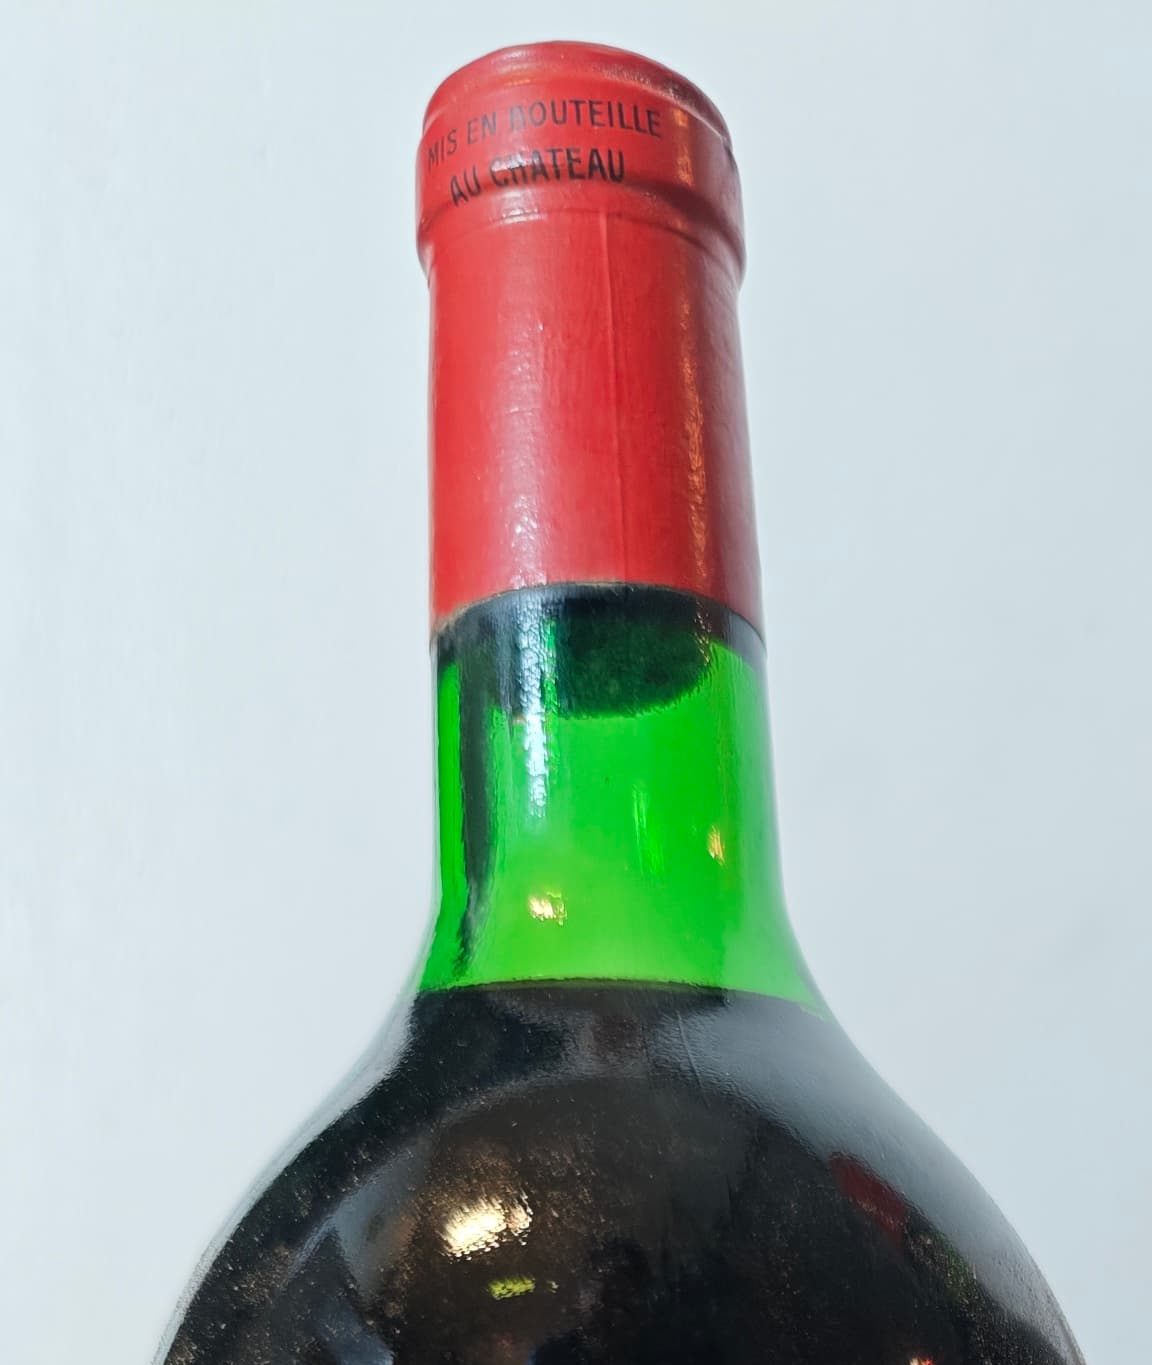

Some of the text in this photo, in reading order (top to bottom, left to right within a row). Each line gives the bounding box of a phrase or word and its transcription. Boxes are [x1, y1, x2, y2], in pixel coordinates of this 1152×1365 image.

[426, 99, 664, 172] MIS EN BOUTEILLE
[449, 147, 625, 206] AU CHATEAU
